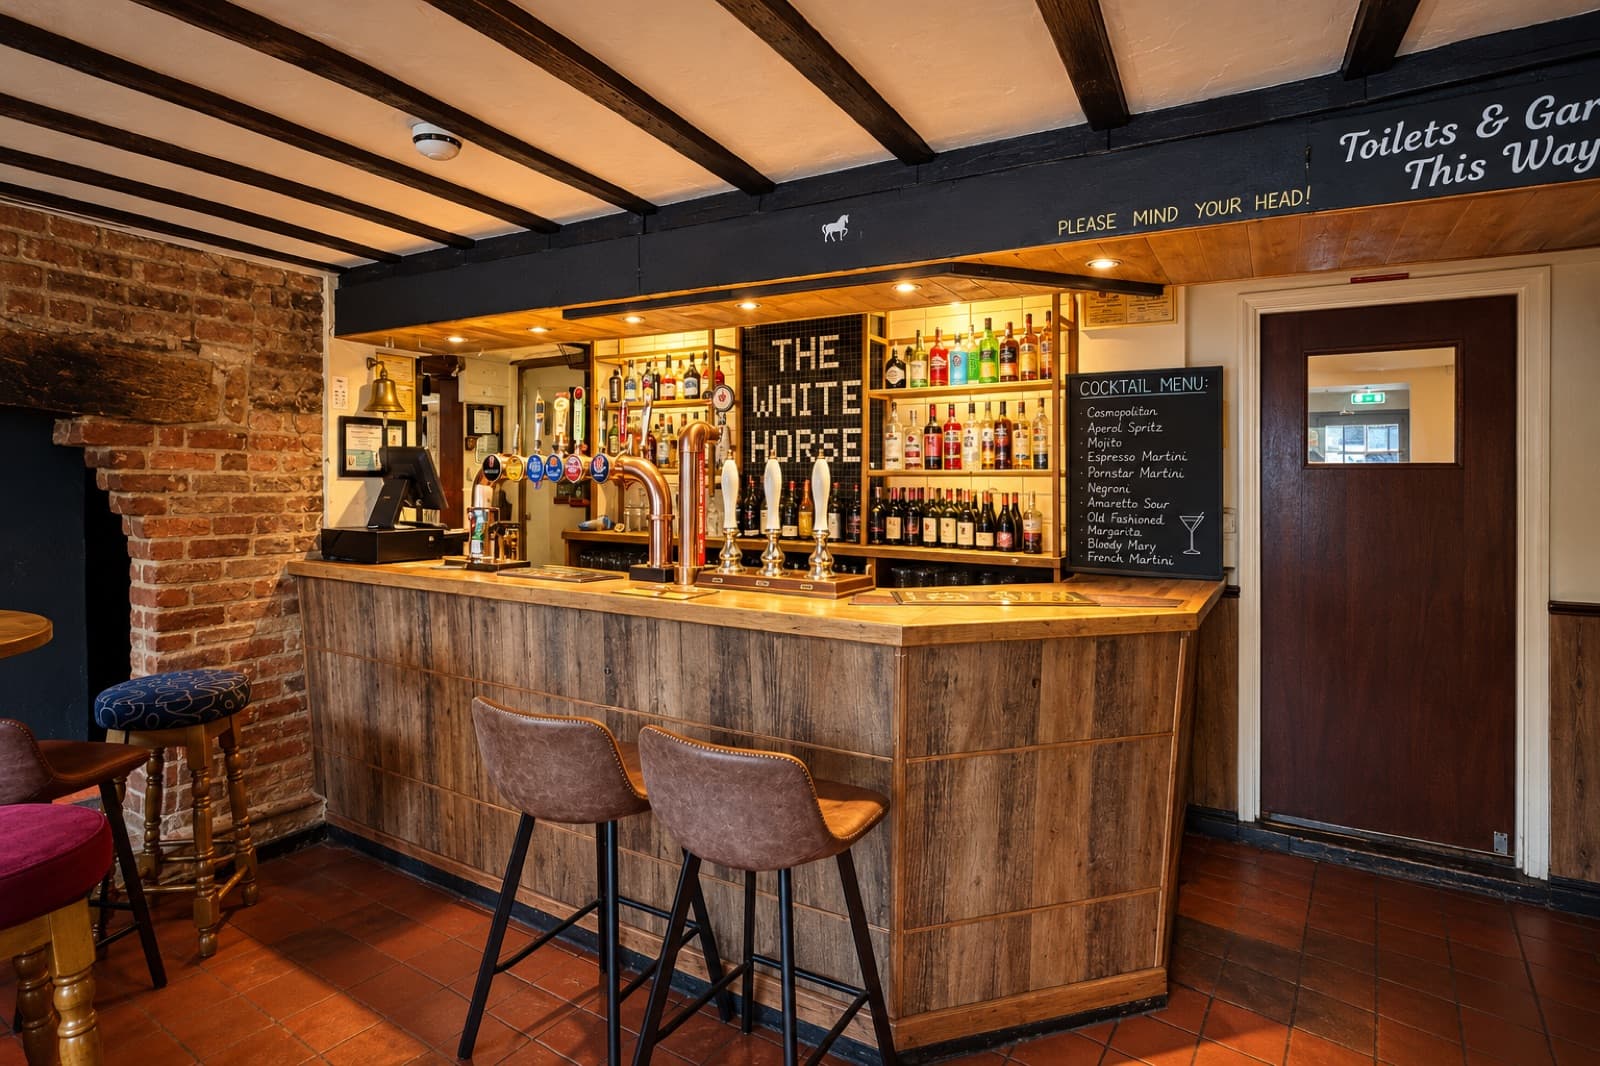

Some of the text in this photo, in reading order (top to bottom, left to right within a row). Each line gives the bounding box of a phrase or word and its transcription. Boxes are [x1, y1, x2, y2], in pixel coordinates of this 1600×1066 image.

[1339, 120, 1458, 163] Toilets
[1475, 103, 1509, 139] &
[1405, 135, 1600, 190] This Way
[1057, 185, 1312, 236] PLEASE MIND YOUR HEAD!
[772, 334, 840, 372] THE
[1080, 376, 1209, 396] COCKTAIL MENU:
[752, 379, 862, 418] WHITE
[1087, 406, 1158, 421] Cosmopolitan
[1087, 421, 1163, 436] Aperol Spritz
[751, 427, 862, 463] HORSE
[1087, 437, 1122, 452] Mojito
[1087, 450, 1188, 465] Espresso Martini
[1087, 466, 1185, 479] Pornstar Martini
[1087, 482, 1131, 497] Negroni
[1087, 497, 1170, 510] Amaretto Sour
[1087, 511, 1165, 525] Old Fashioned
[1087, 538, 1157, 555] Bloody Mary
[1087, 551, 1175, 566] French Martini
